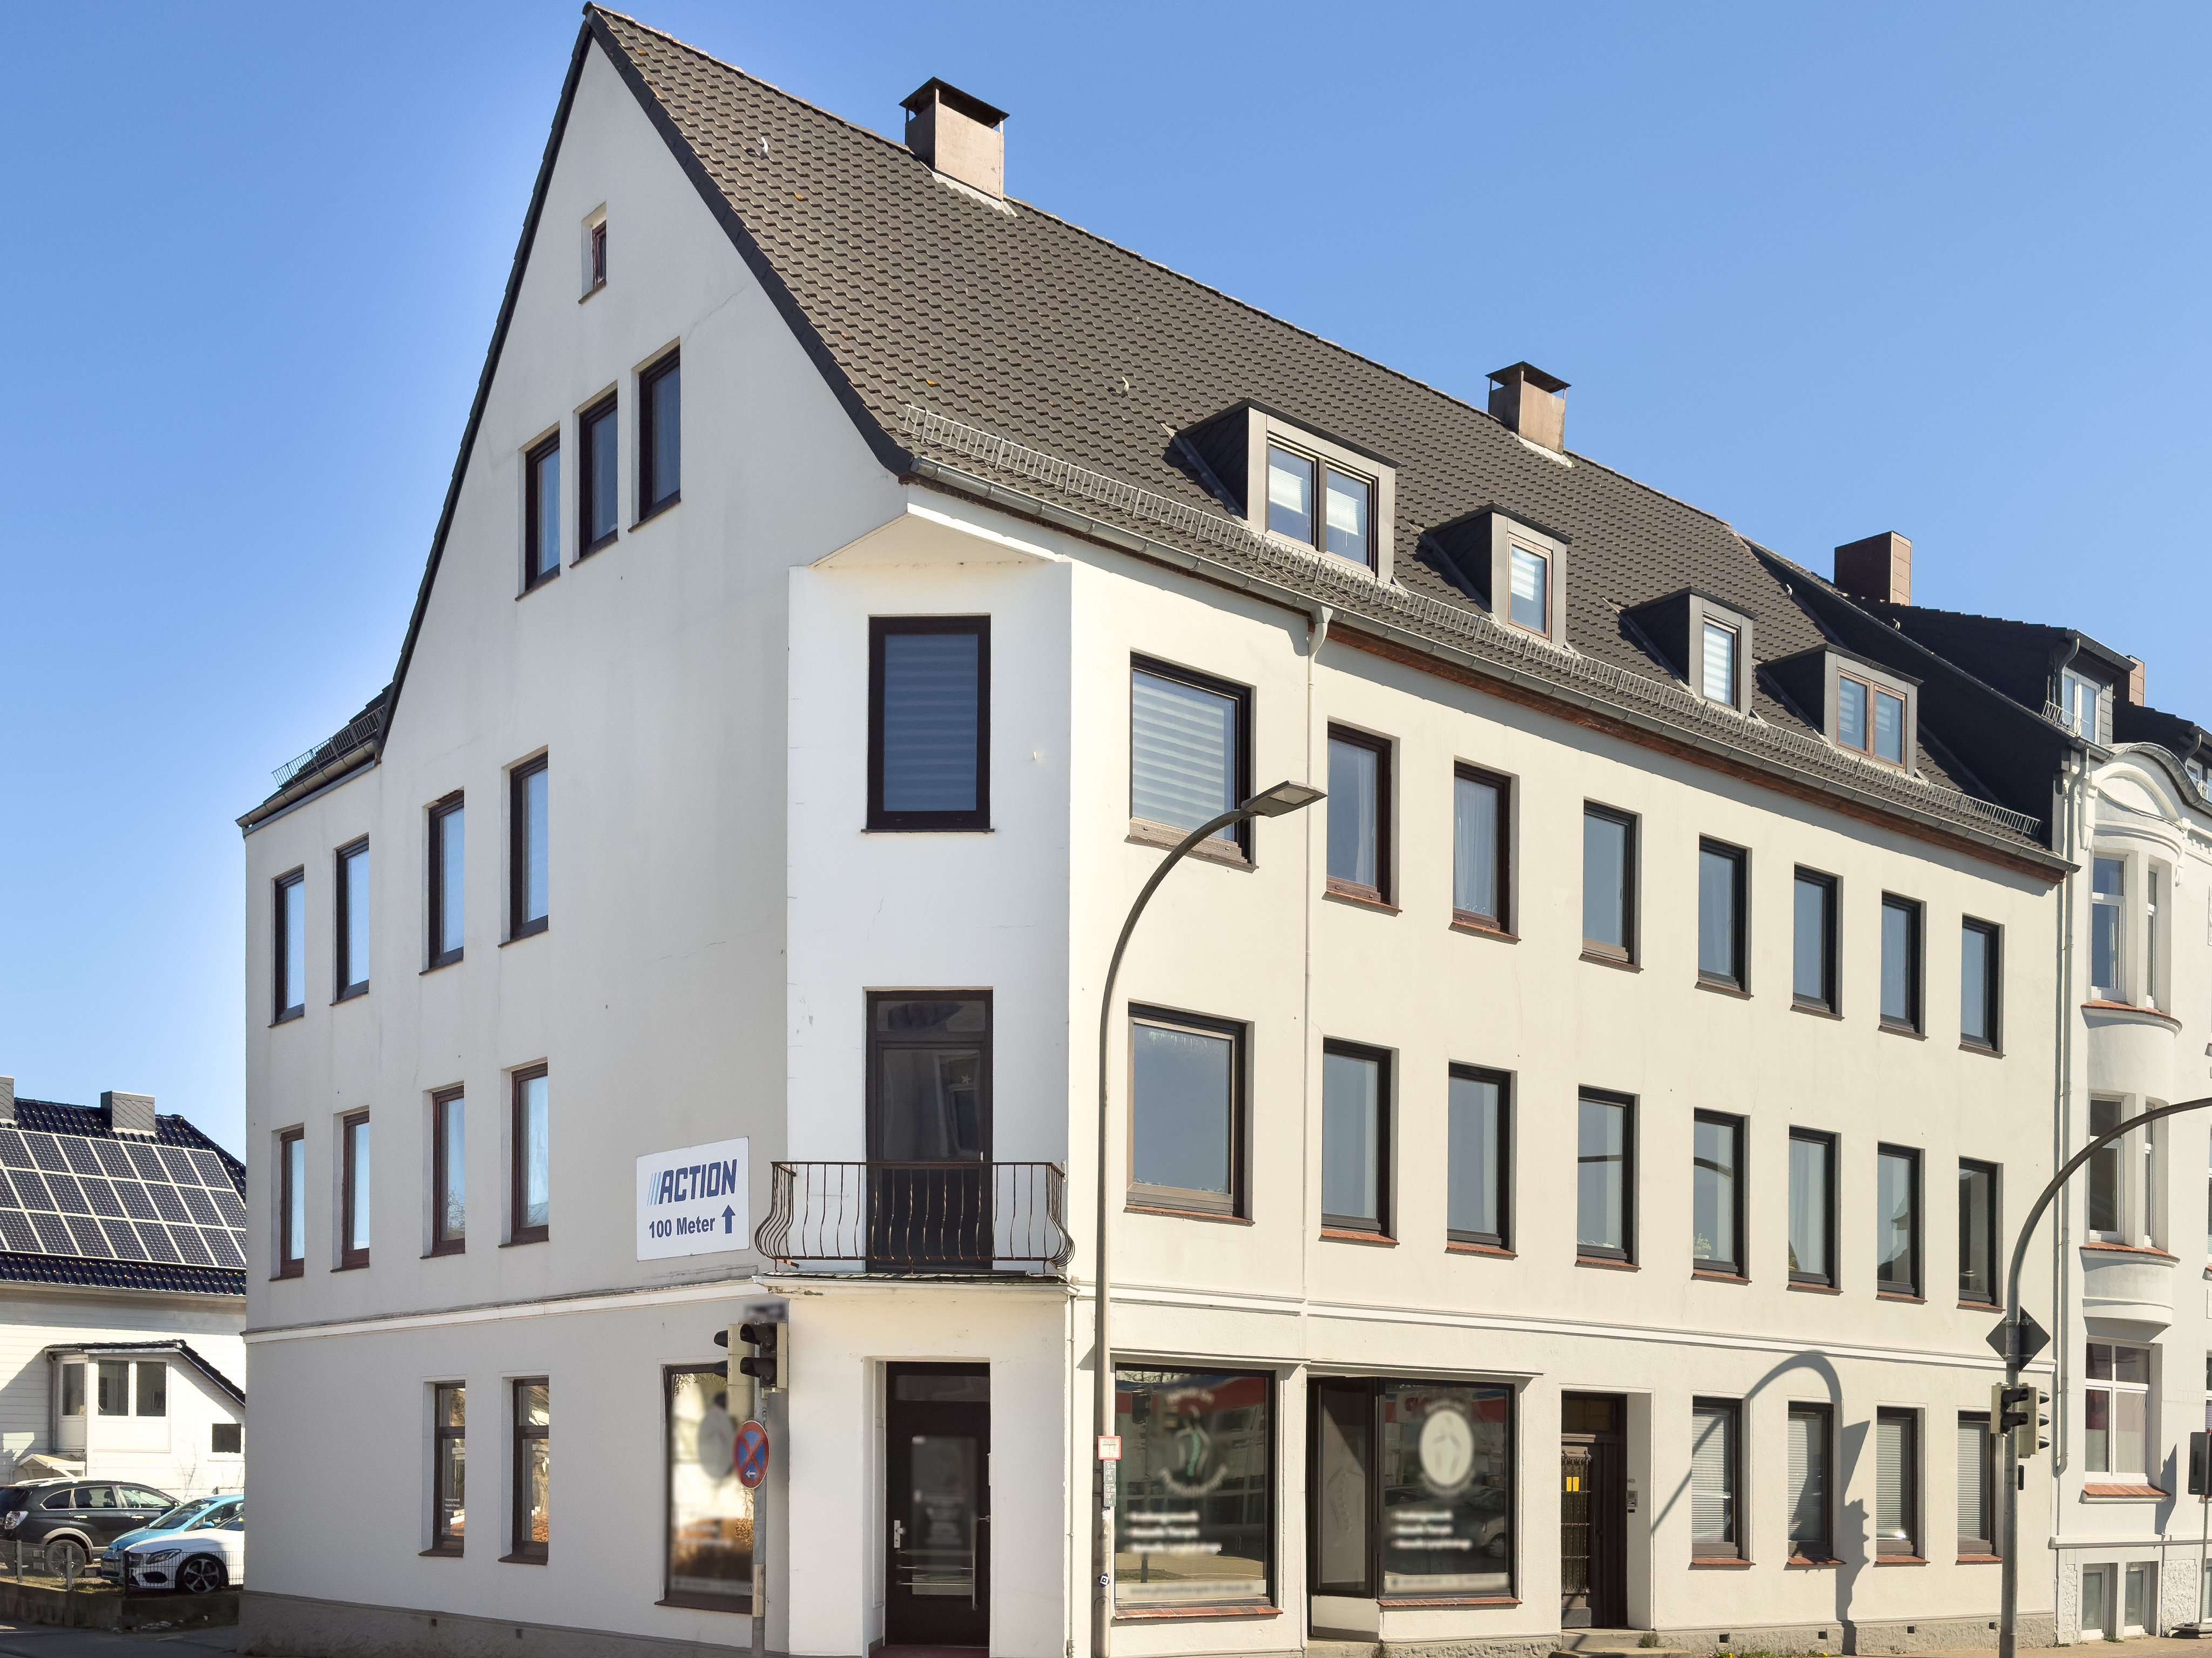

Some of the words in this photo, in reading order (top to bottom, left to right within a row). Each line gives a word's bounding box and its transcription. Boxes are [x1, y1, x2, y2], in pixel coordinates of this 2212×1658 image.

[658, 1159, 737, 1204] ACTION
[649, 1219, 672, 1239] 100
[677, 1216, 716, 1235] Meter
